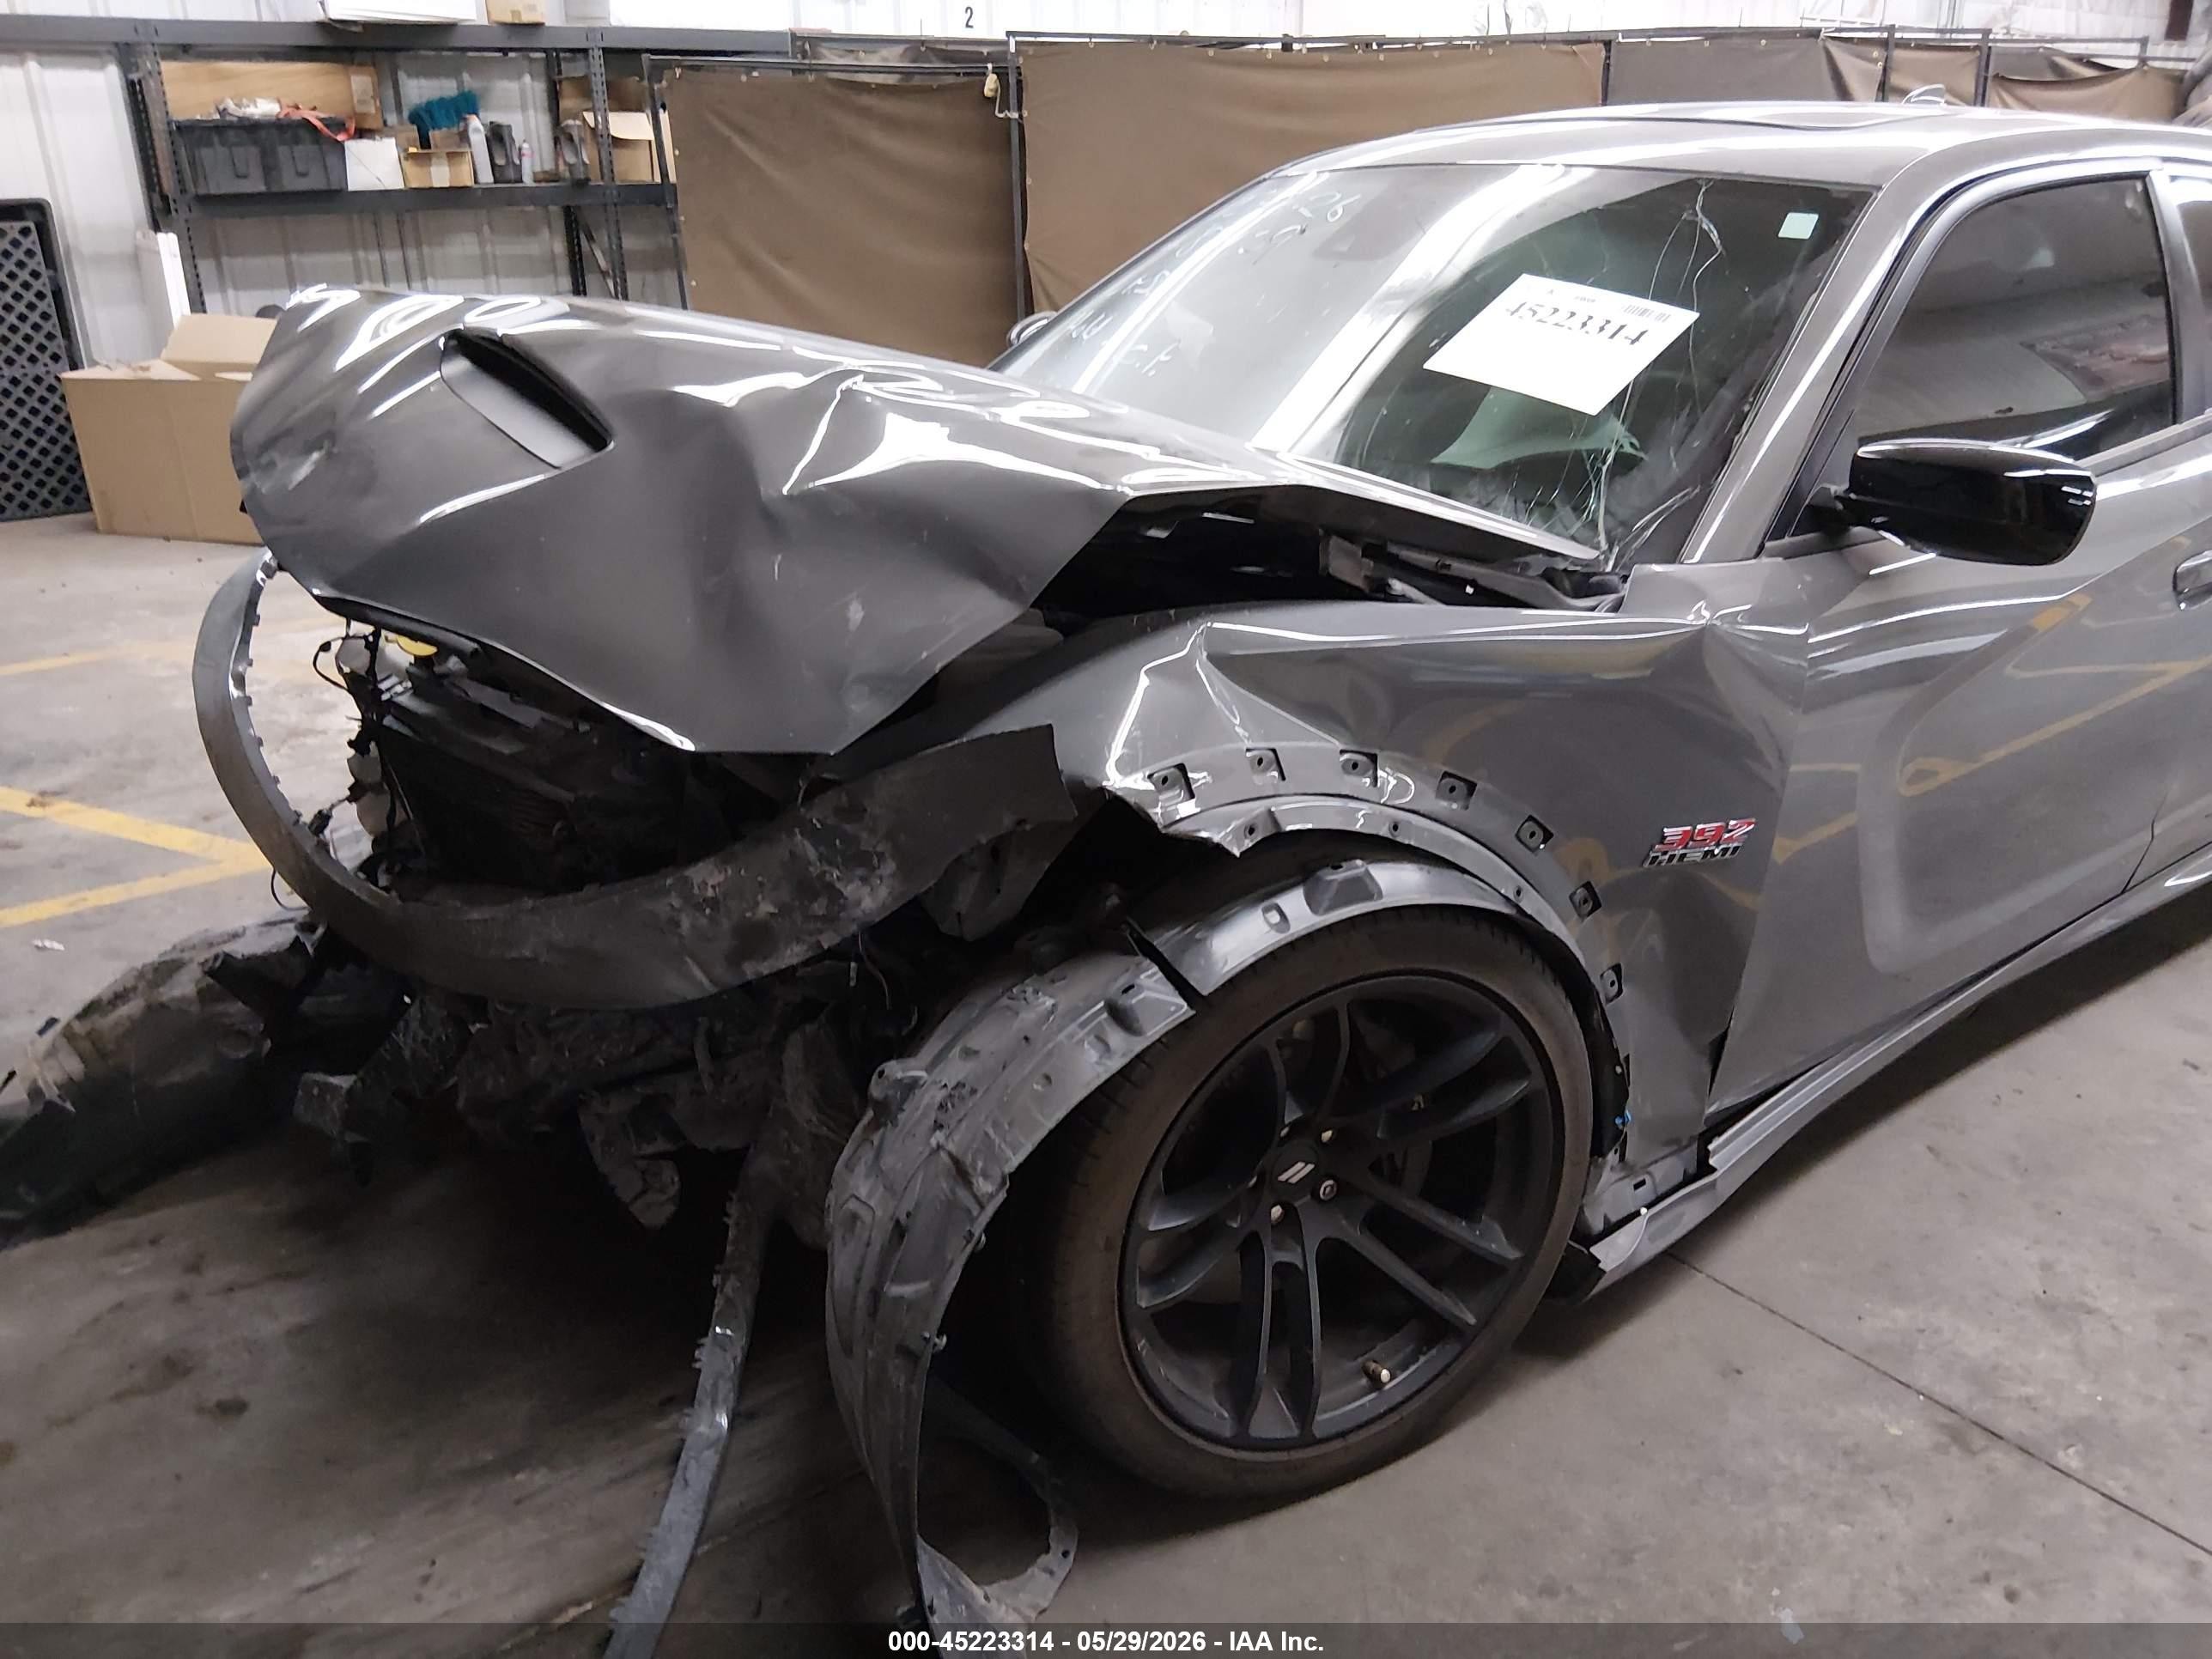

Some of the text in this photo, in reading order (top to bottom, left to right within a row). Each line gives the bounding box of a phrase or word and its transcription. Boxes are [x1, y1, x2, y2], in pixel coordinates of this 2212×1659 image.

[964, 6, 974, 28] 2
[1505, 301, 1650, 346] 45223314
[1655, 817, 1757, 851] 392
[1643, 843, 1743, 868] HEMI
